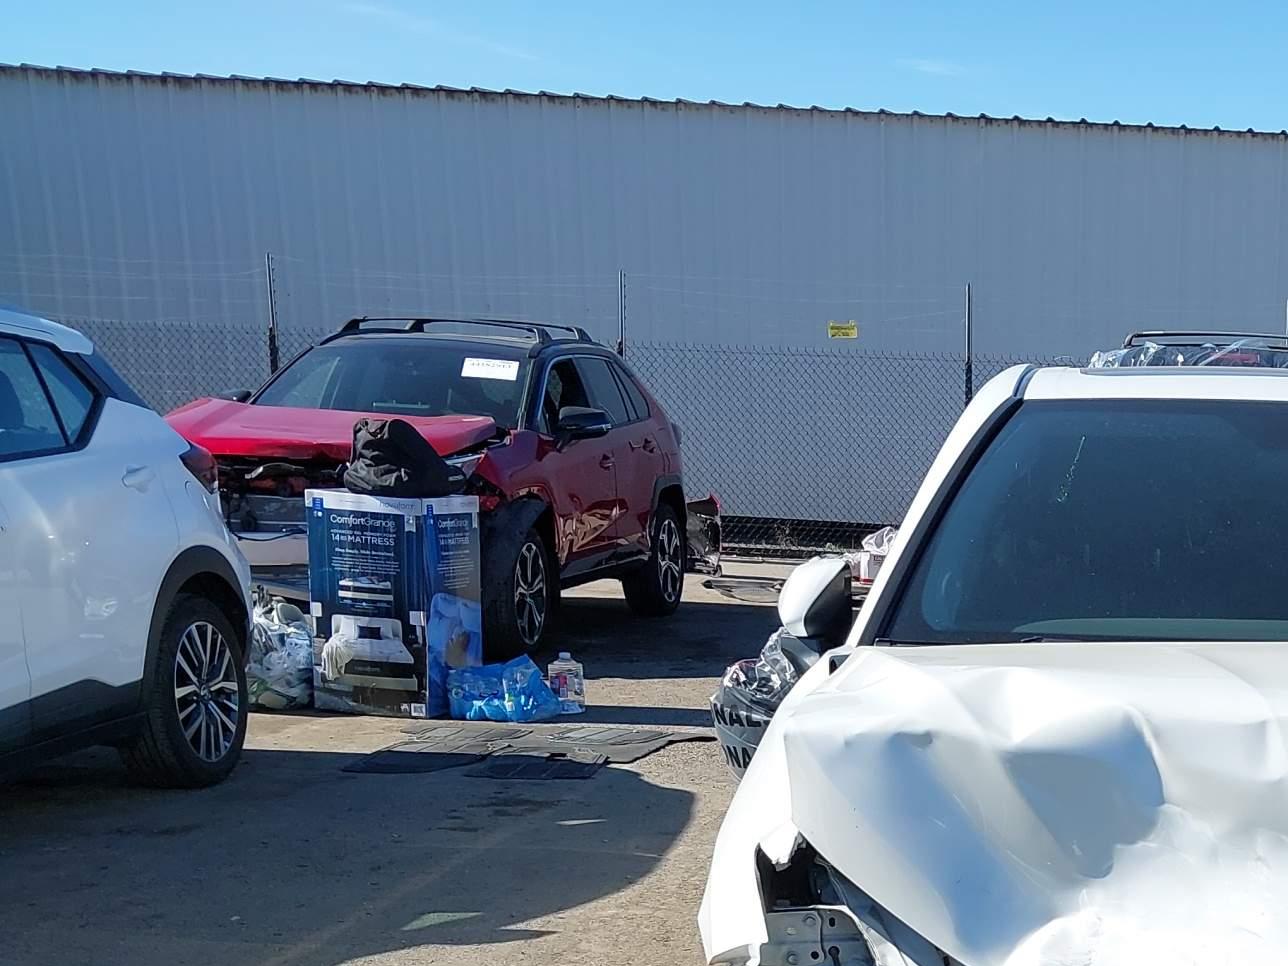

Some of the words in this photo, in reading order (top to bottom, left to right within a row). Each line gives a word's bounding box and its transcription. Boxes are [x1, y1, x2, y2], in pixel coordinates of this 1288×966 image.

[330, 513, 396, 528] ComfortGrande
[331, 533, 340, 542] 14
[347, 534, 395, 546] MATTRESS
